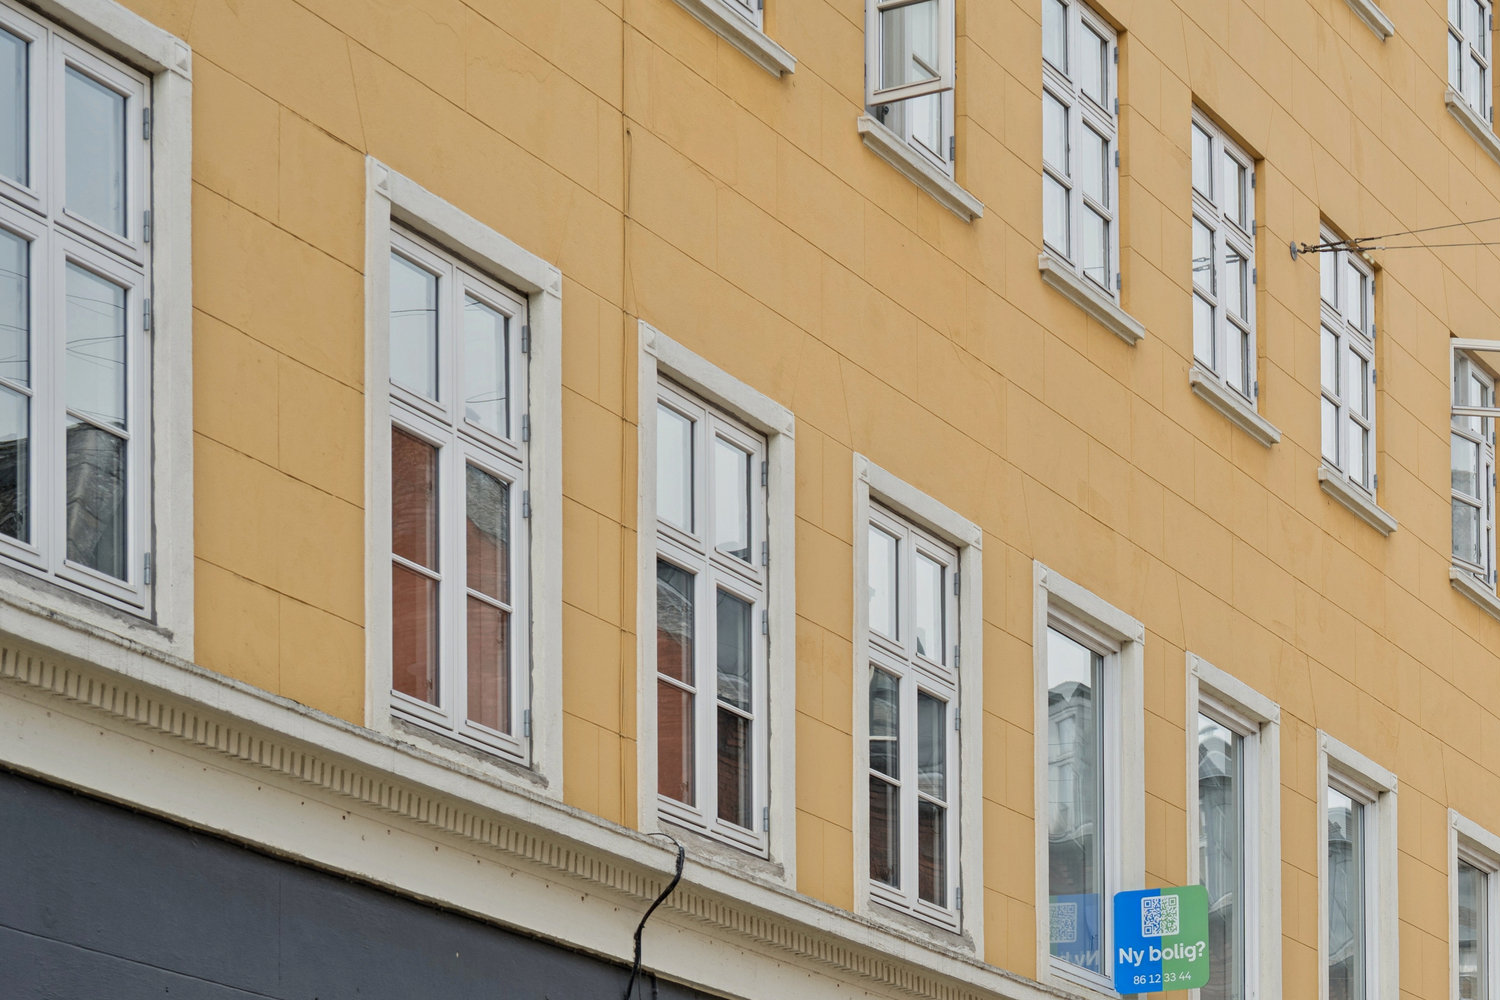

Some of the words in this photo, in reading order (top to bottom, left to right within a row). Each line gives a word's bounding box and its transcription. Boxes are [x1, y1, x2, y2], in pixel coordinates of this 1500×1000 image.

[1118, 946, 1144, 967] Ny
[1149, 941, 1206, 962] bolig?
[1133, 975, 1146, 985] 86
[1149, 973, 1161, 983] 12
[1164, 972, 1176, 982] 33
[1179, 971, 1191, 981] 44
